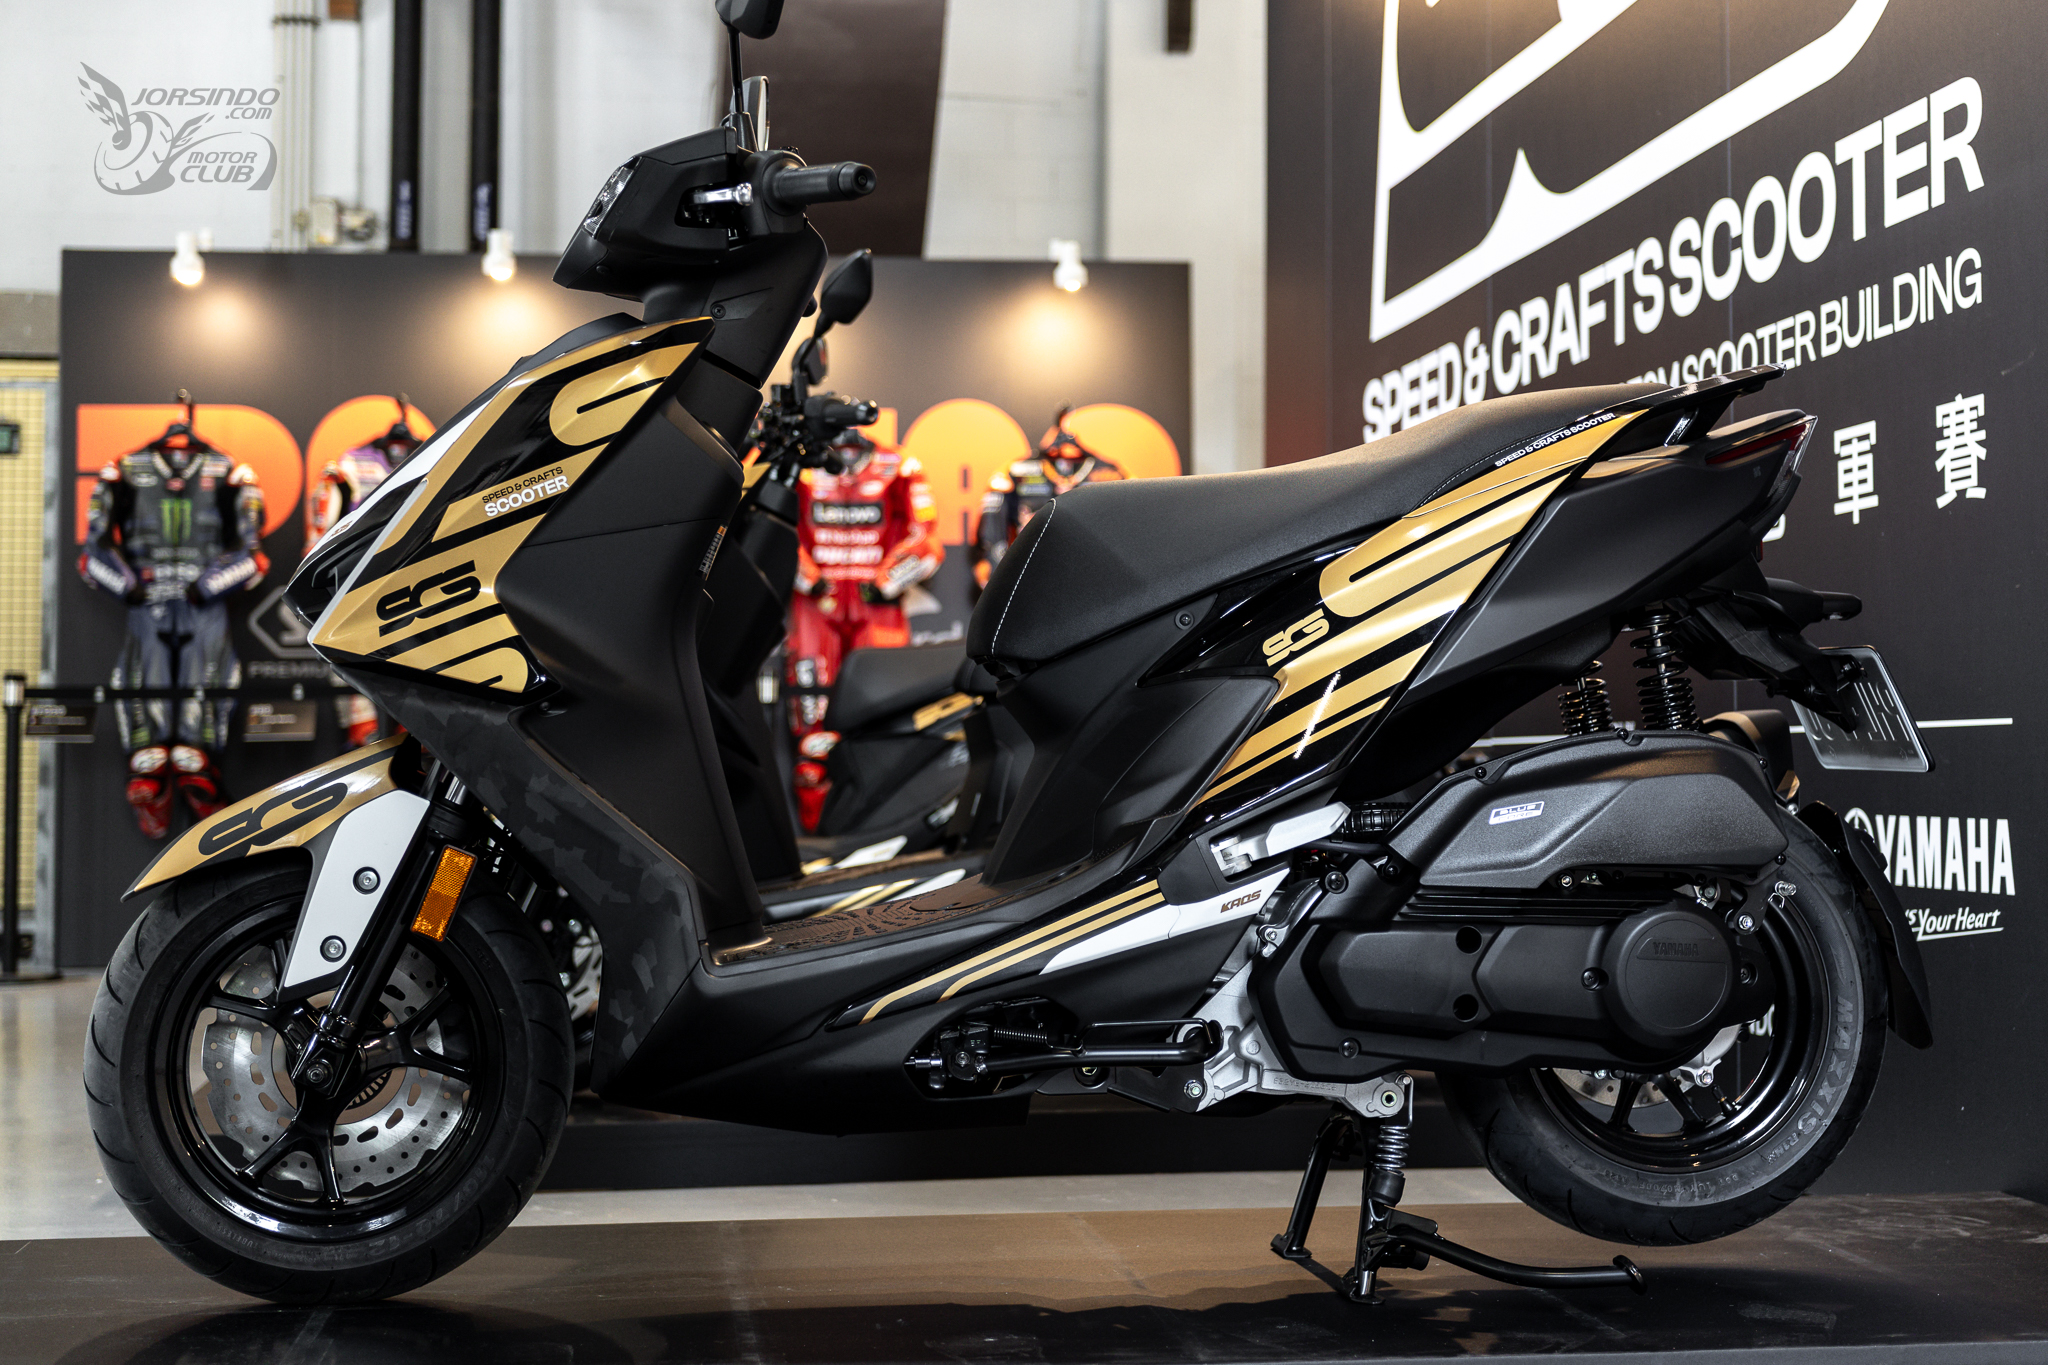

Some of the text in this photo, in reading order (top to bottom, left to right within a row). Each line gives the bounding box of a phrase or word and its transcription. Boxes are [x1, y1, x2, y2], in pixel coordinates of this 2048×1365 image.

[1363, 76, 1985, 443] SPEED & CRAFTS SCOOTER
[1820, 247, 1983, 358] BUILDING
[1494, 448, 1526, 468] SPEED
[1533, 428, 1572, 450] CRAFTS
[1570, 412, 1617, 434] SCOOTER
[482, 485, 514, 504] SPEED
[522, 466, 564, 489] CRAFTS
[484, 474, 570, 518] SCOOTER
[1875, 813, 2016, 896] YAMAHA
[1652, 941, 1699, 958] YAMAHA
[1917, 907, 1956, 938] Your
[1955, 906, 2001, 932] Heart
[1797, 994, 1855, 1135] MAXXIS
